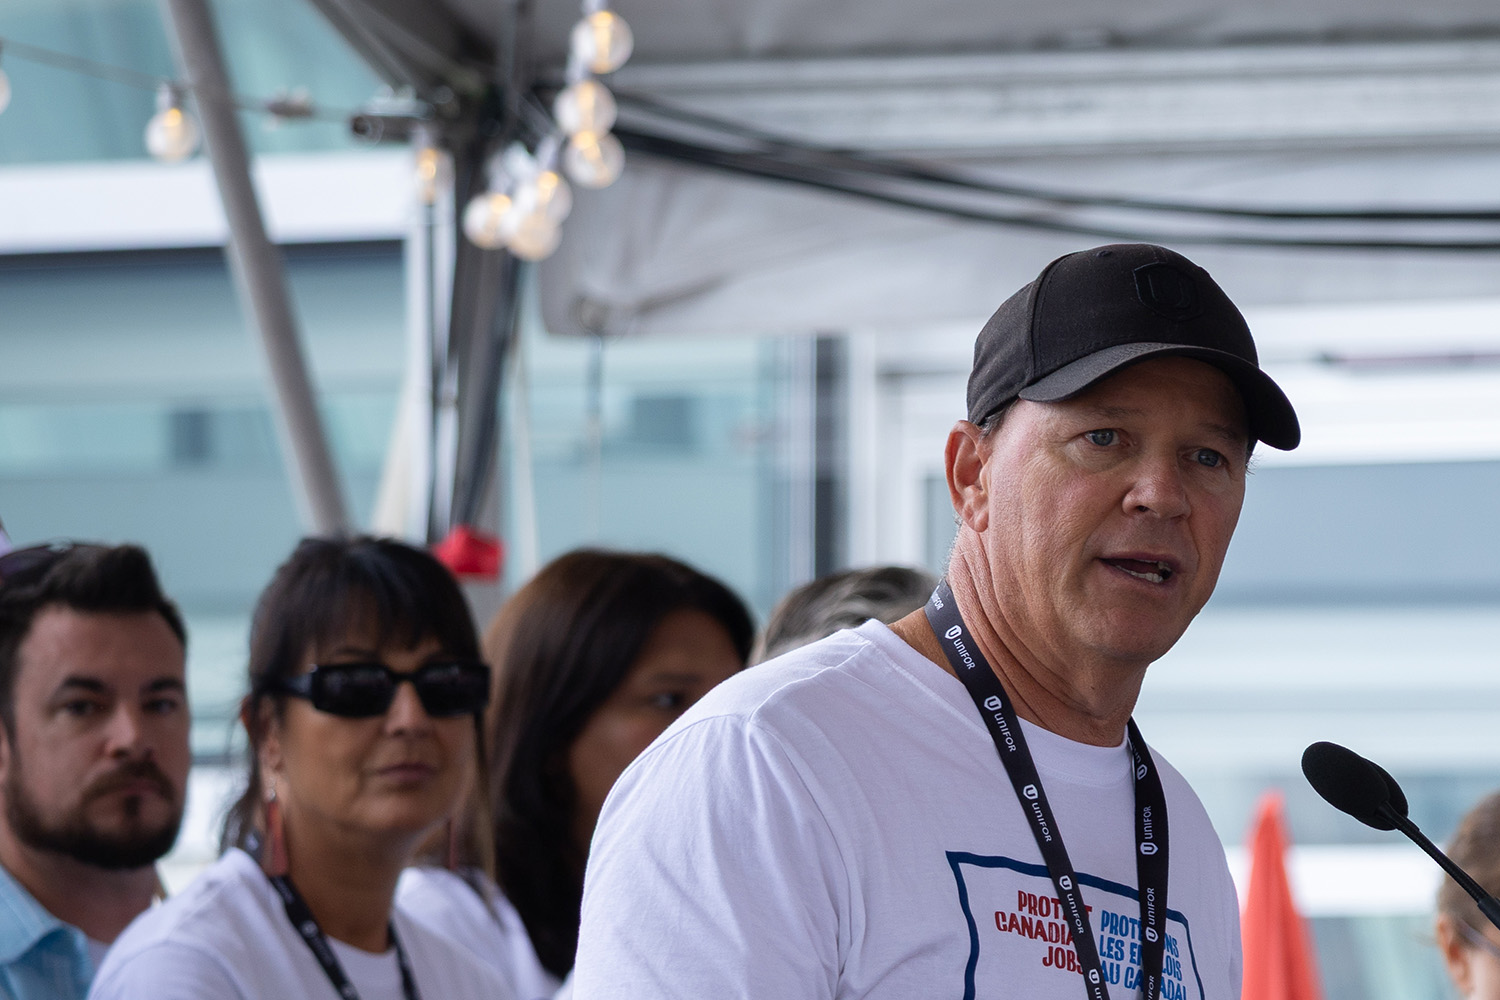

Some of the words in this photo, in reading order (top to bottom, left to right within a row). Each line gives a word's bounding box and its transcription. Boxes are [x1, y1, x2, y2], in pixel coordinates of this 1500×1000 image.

[994, 911, 1076, 946] CANADIA
[1100, 935, 1125, 962] LES
[1100, 960, 1120, 985] AU
